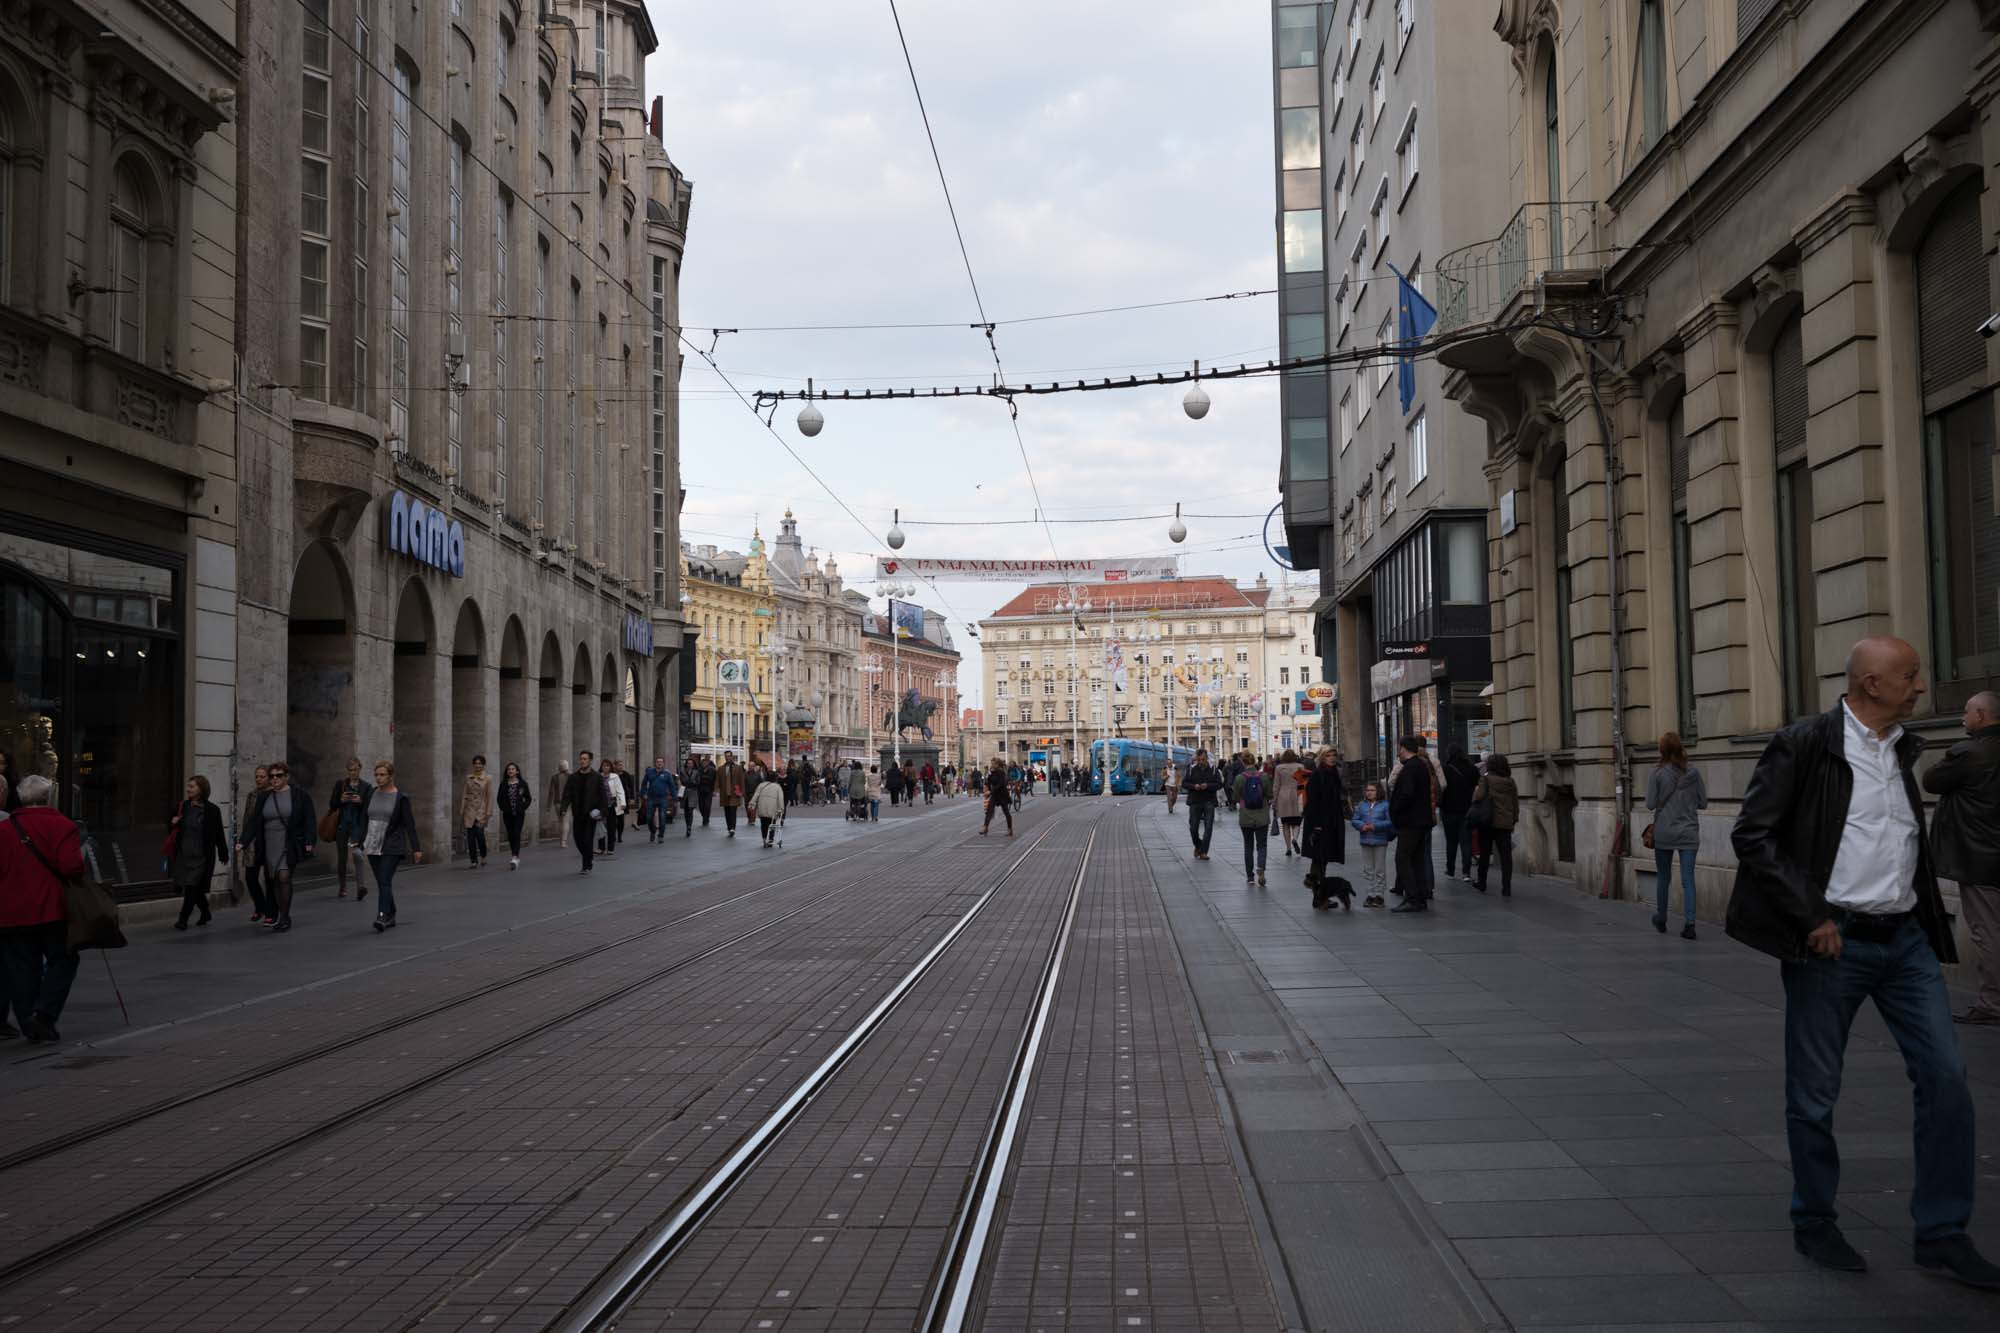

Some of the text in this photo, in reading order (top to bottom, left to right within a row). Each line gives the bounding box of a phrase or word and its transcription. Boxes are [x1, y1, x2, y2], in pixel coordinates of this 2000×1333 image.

[390, 489, 465, 578] nama
[918, 559, 933, 569] 17.
[1000, 560, 1027, 571] NAJ
